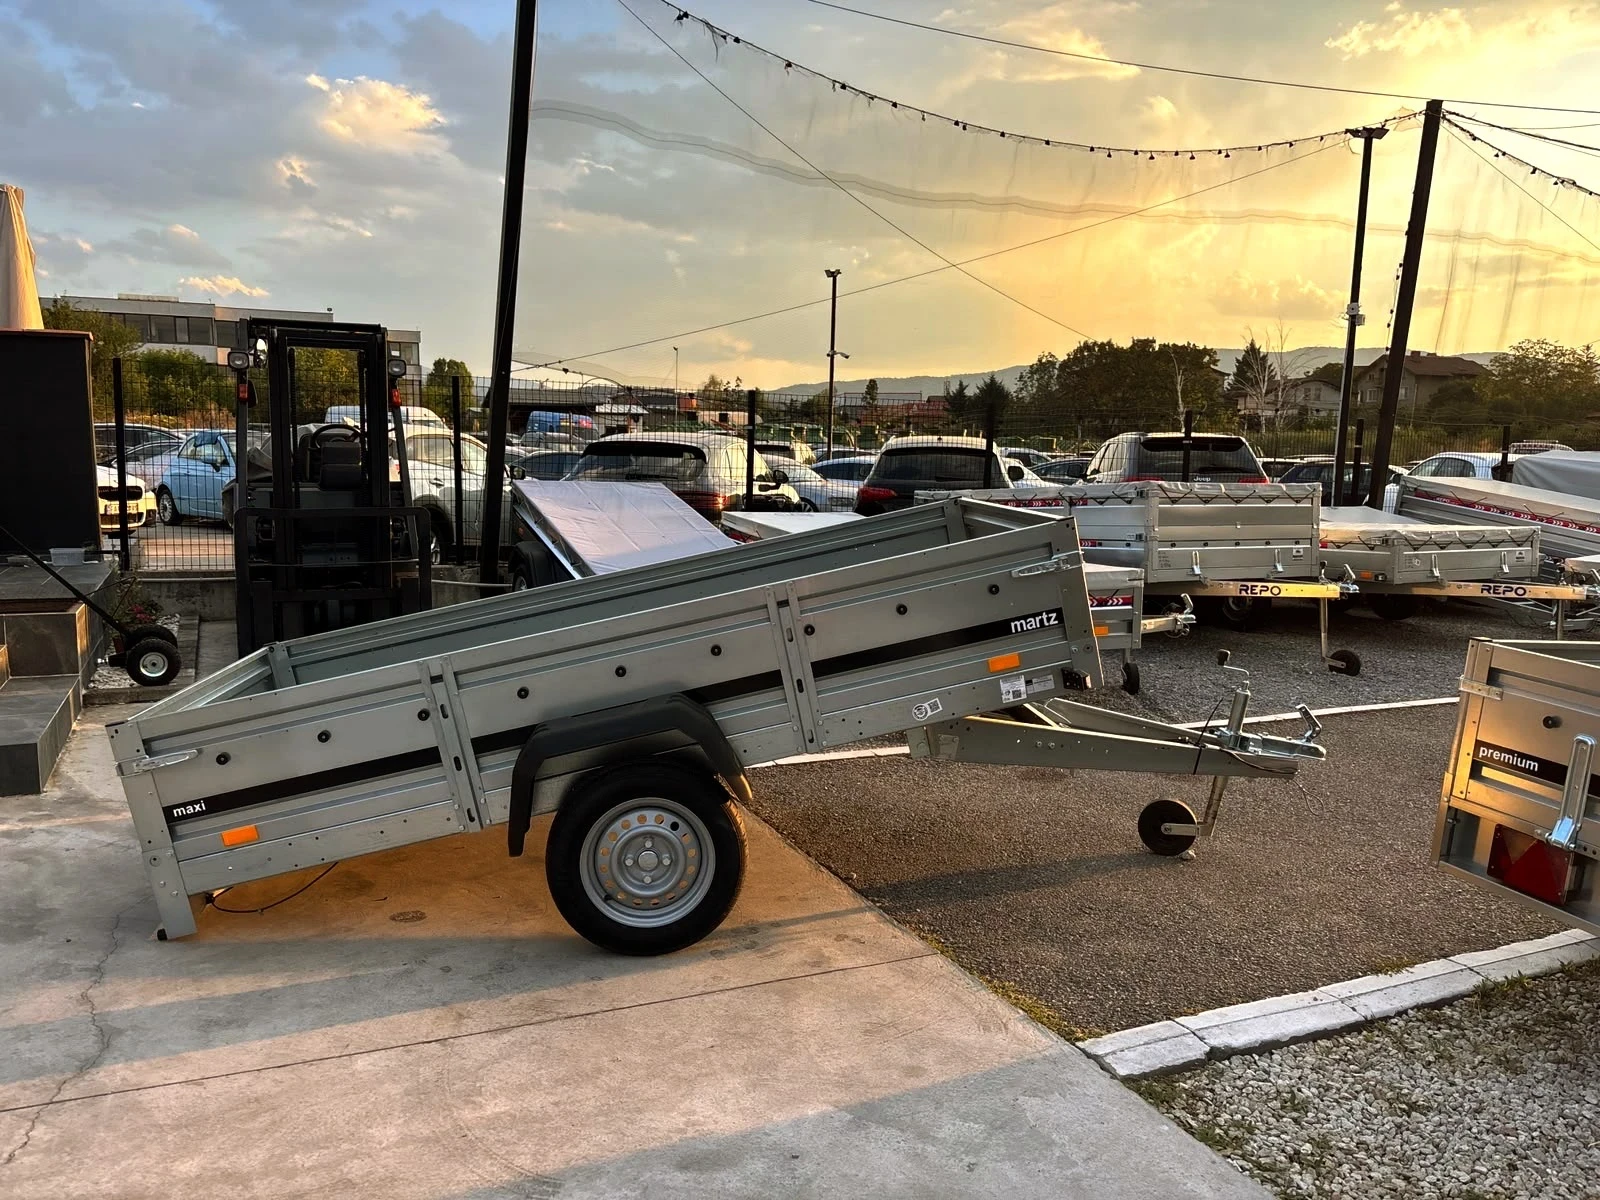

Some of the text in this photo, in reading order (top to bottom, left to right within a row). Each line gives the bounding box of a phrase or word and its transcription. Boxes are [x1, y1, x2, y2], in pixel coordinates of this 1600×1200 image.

[1239, 584, 1281, 596] REPO
[1480, 584, 1527, 597] REPO
[1010, 611, 1059, 633] martz
[1478, 746, 1539, 772] premium
[172, 799, 206, 818] maxi
